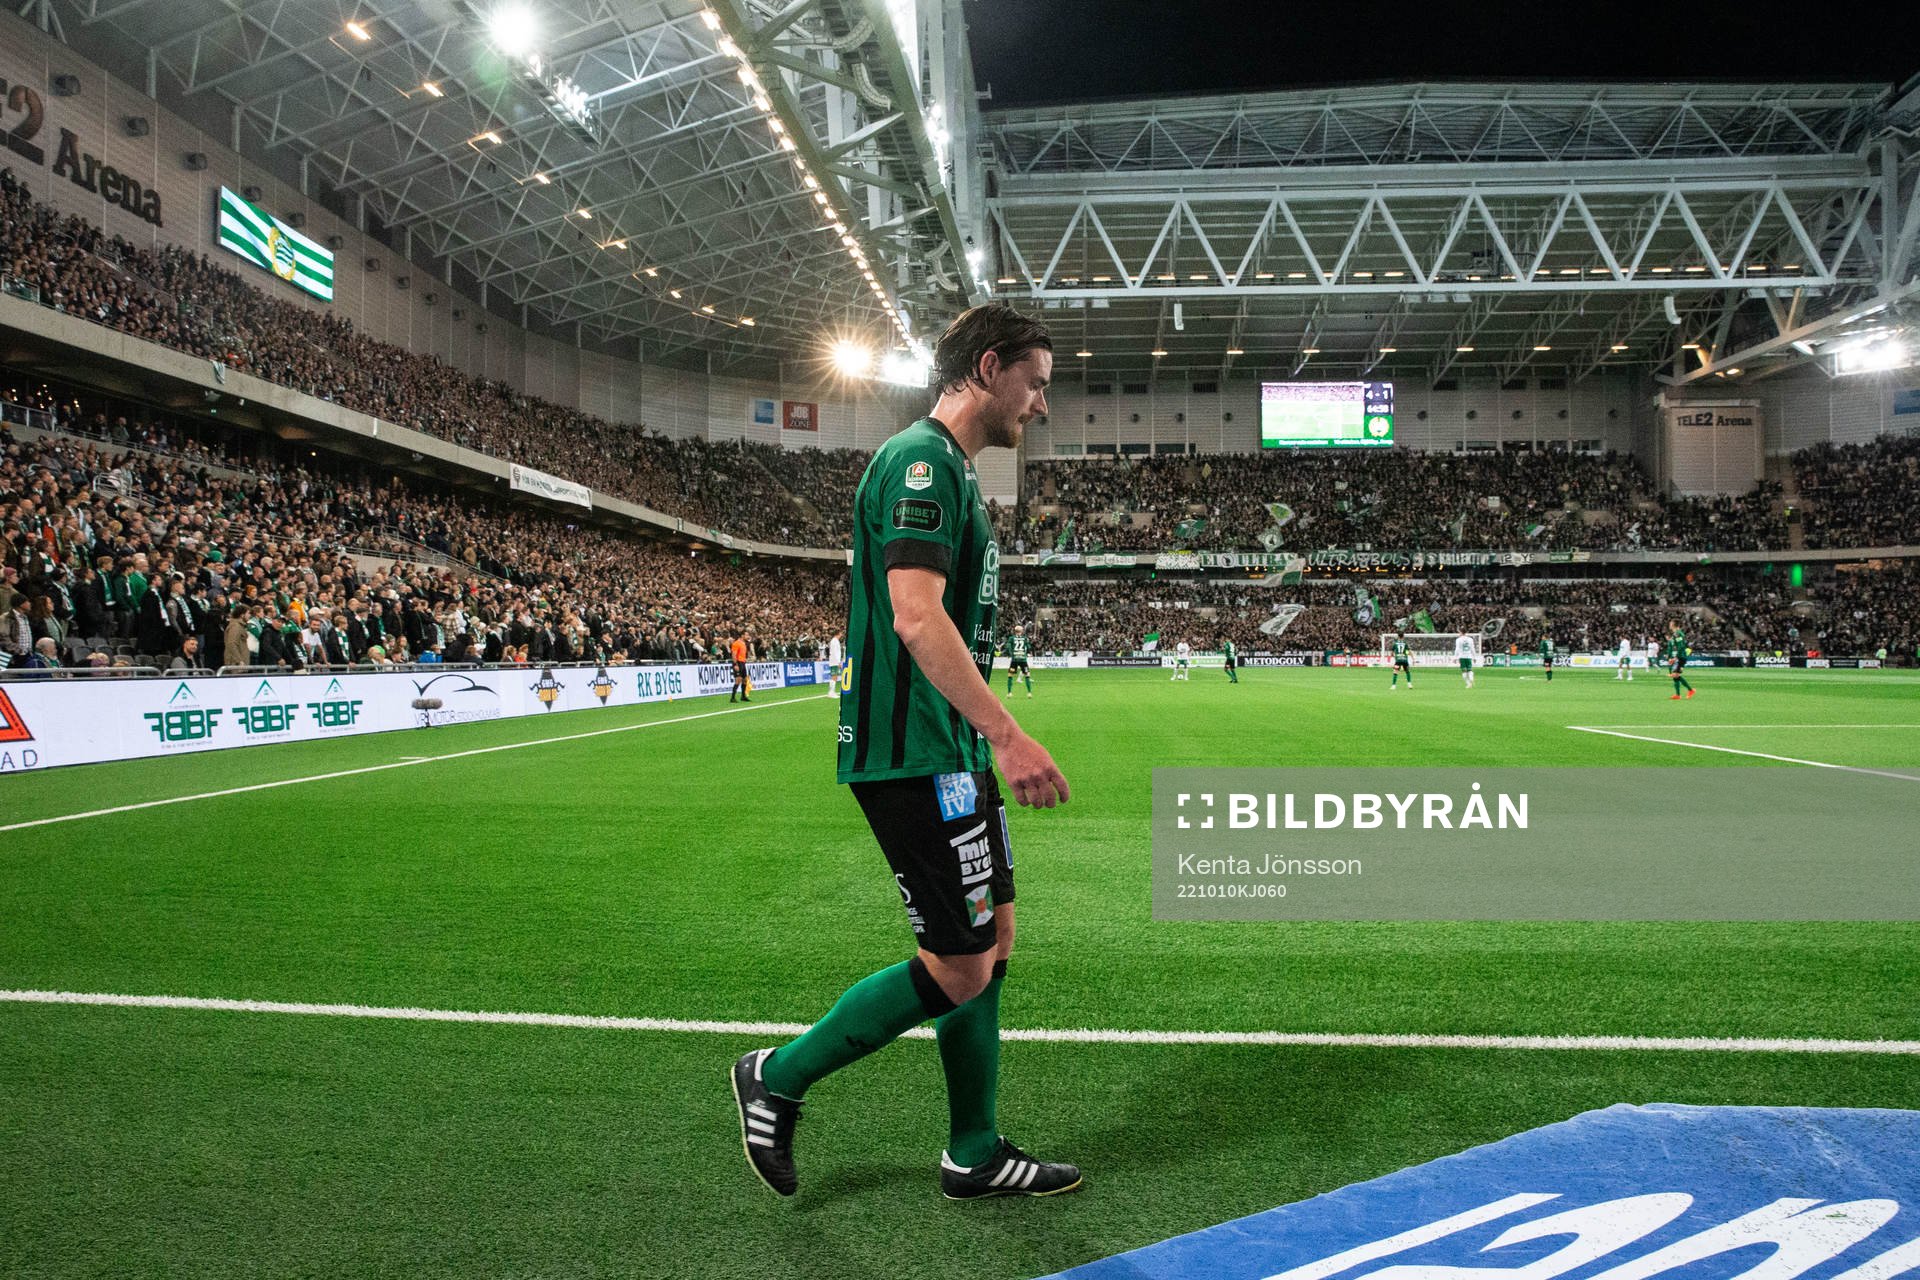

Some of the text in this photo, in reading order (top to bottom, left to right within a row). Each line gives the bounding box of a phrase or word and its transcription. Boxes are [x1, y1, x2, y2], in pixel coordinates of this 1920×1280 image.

[0, 77, 163, 228] 2 Arena
[1677, 412, 1752, 426] TELE2 Arena
[895, 506, 938, 520] UNIBET
[1013, 640, 1025, 651] 22
[1244, 657, 1305, 666] METODGOLV
[1755, 656, 1791, 664] SASCHAS
[698, 665, 735, 686] KOMPOTE
[747, 664, 781, 682] KOMPOTEK
[637, 667, 682, 698] RK BYGG
[0, 749, 38, 770] AD
